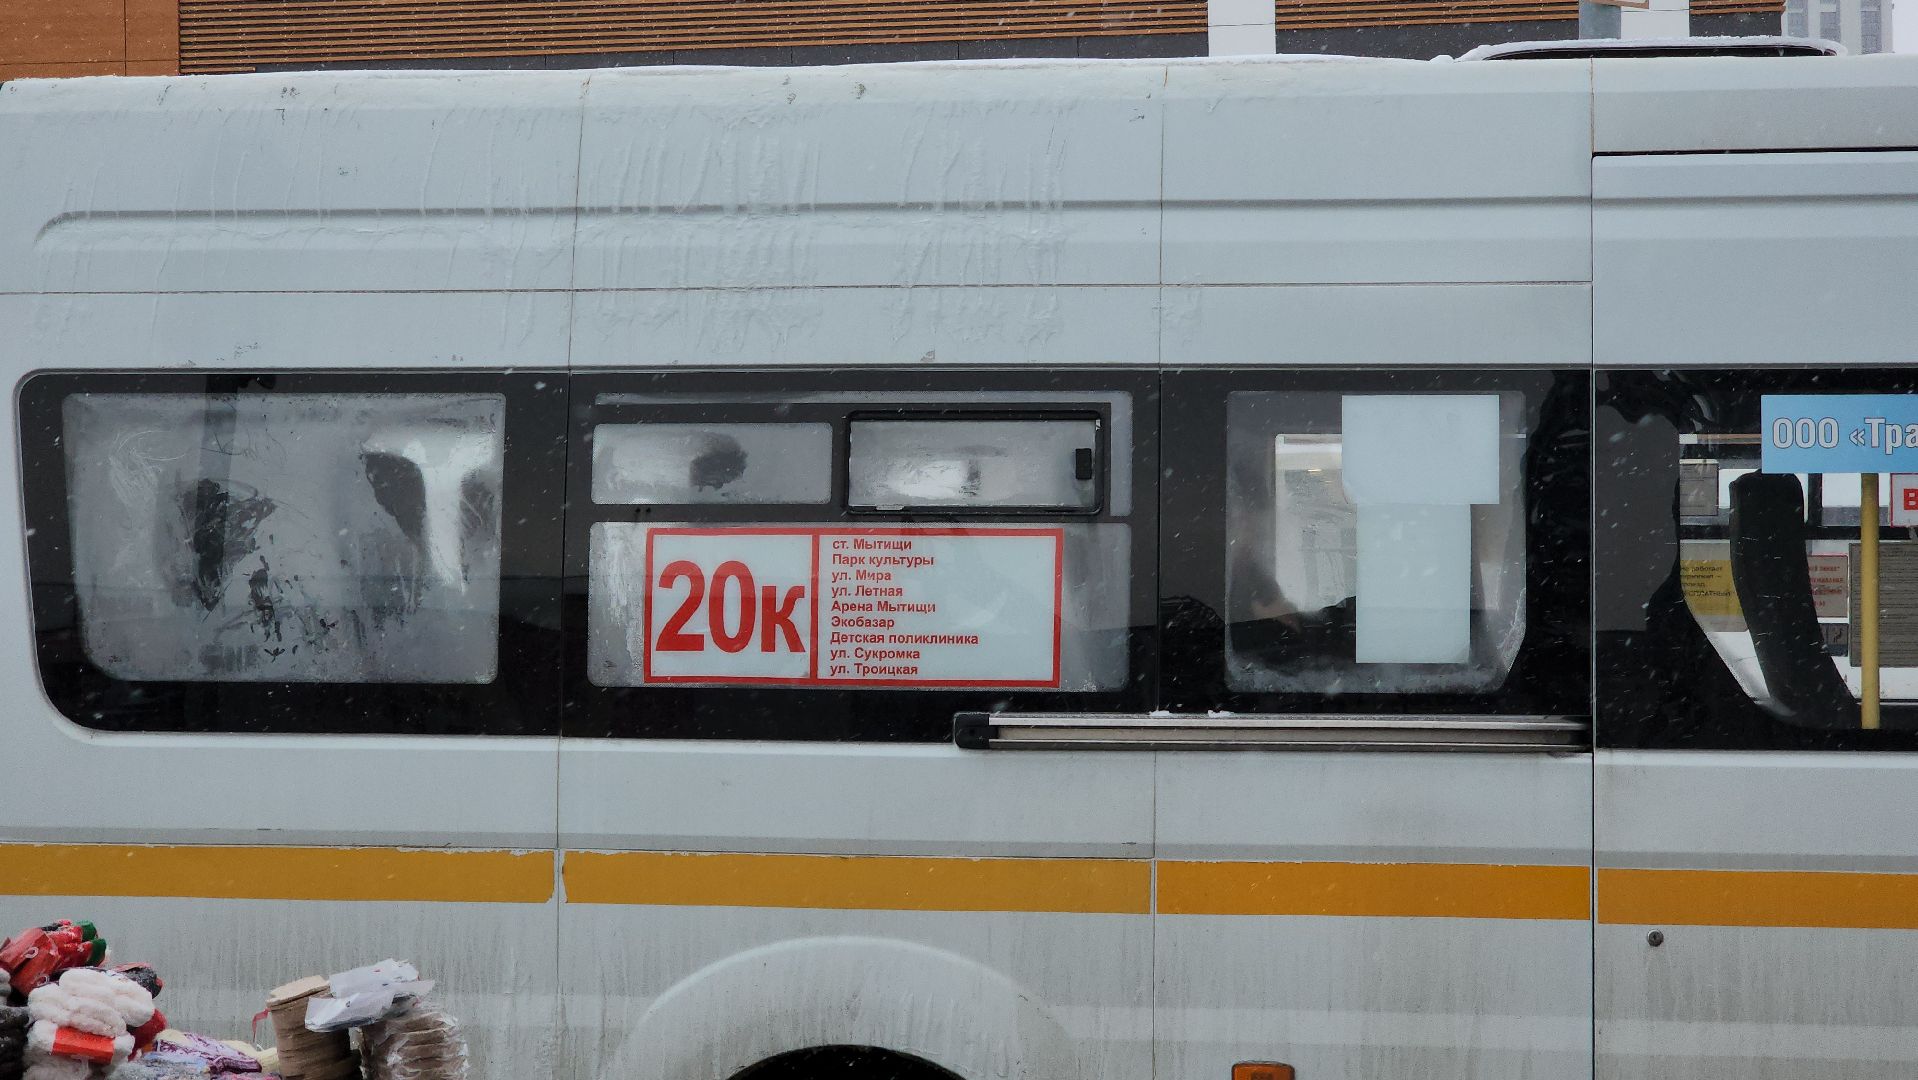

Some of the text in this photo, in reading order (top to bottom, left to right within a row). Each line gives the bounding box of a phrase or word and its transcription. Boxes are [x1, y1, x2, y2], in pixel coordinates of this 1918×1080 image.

[1773, 417, 1840, 449] ООО
[832, 538, 912, 551] ст. Мытищи
[832, 553, 934, 568] Парк культуры
[831, 570, 892, 583] ул. Мира
[831, 585, 903, 598] ул. Летная
[831, 601, 936, 614] Арена Мытищи
[831, 616, 895, 630] Экобазар
[830, 632, 979, 644] Детская поликлиника
[830, 647, 920, 661] ул. Сукромка
[830, 663, 918, 676] ул. Троицкая
